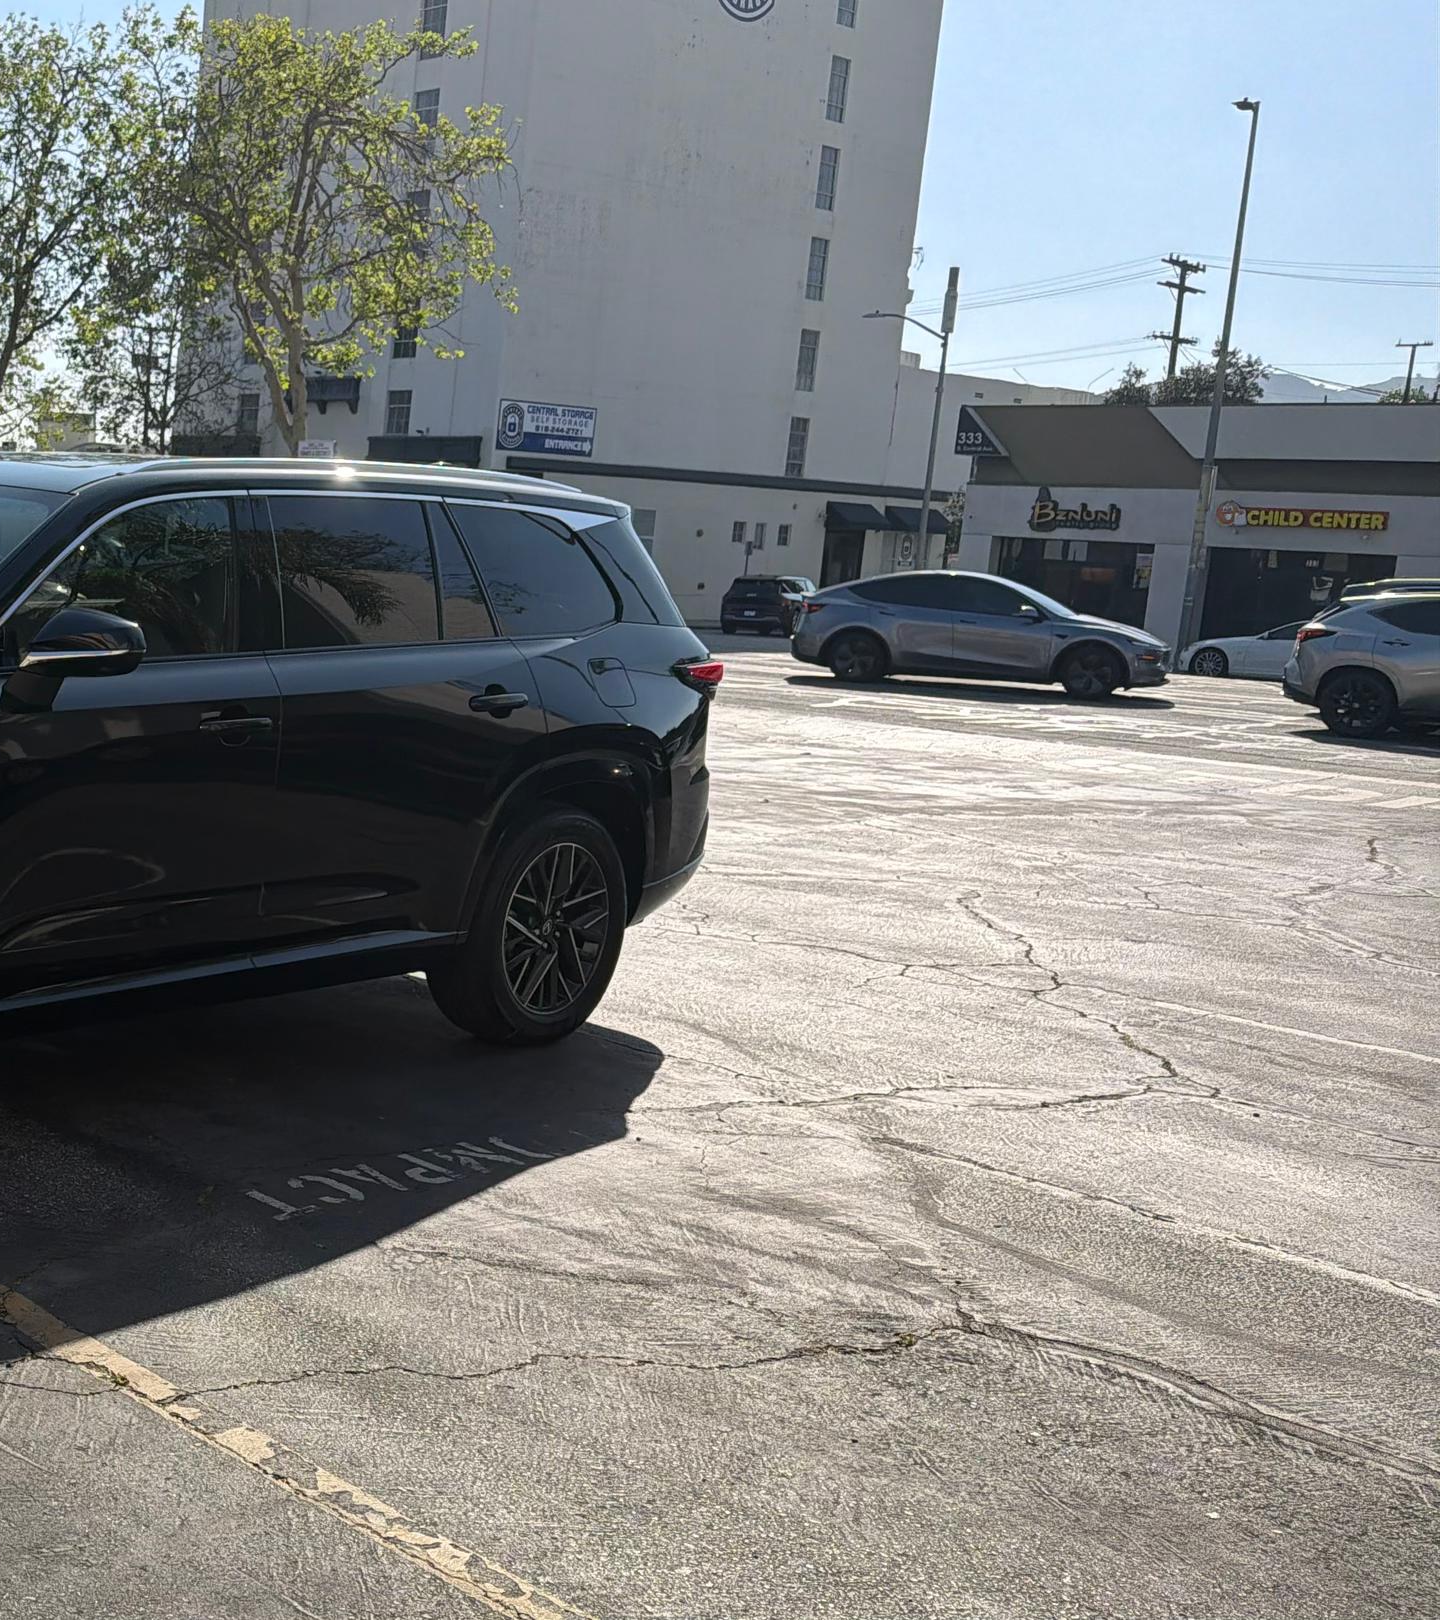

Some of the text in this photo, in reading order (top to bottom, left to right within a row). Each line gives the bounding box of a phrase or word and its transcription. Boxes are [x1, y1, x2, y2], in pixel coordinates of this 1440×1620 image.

[527, 405, 594, 420] CENTRAL STORAGE
[530, 415, 589, 428] SELF STORAGE
[544, 438, 582, 451] ENTRANCE
[958, 432, 983, 444] 333
[1247, 510, 1385, 530] CHILD CENTER
